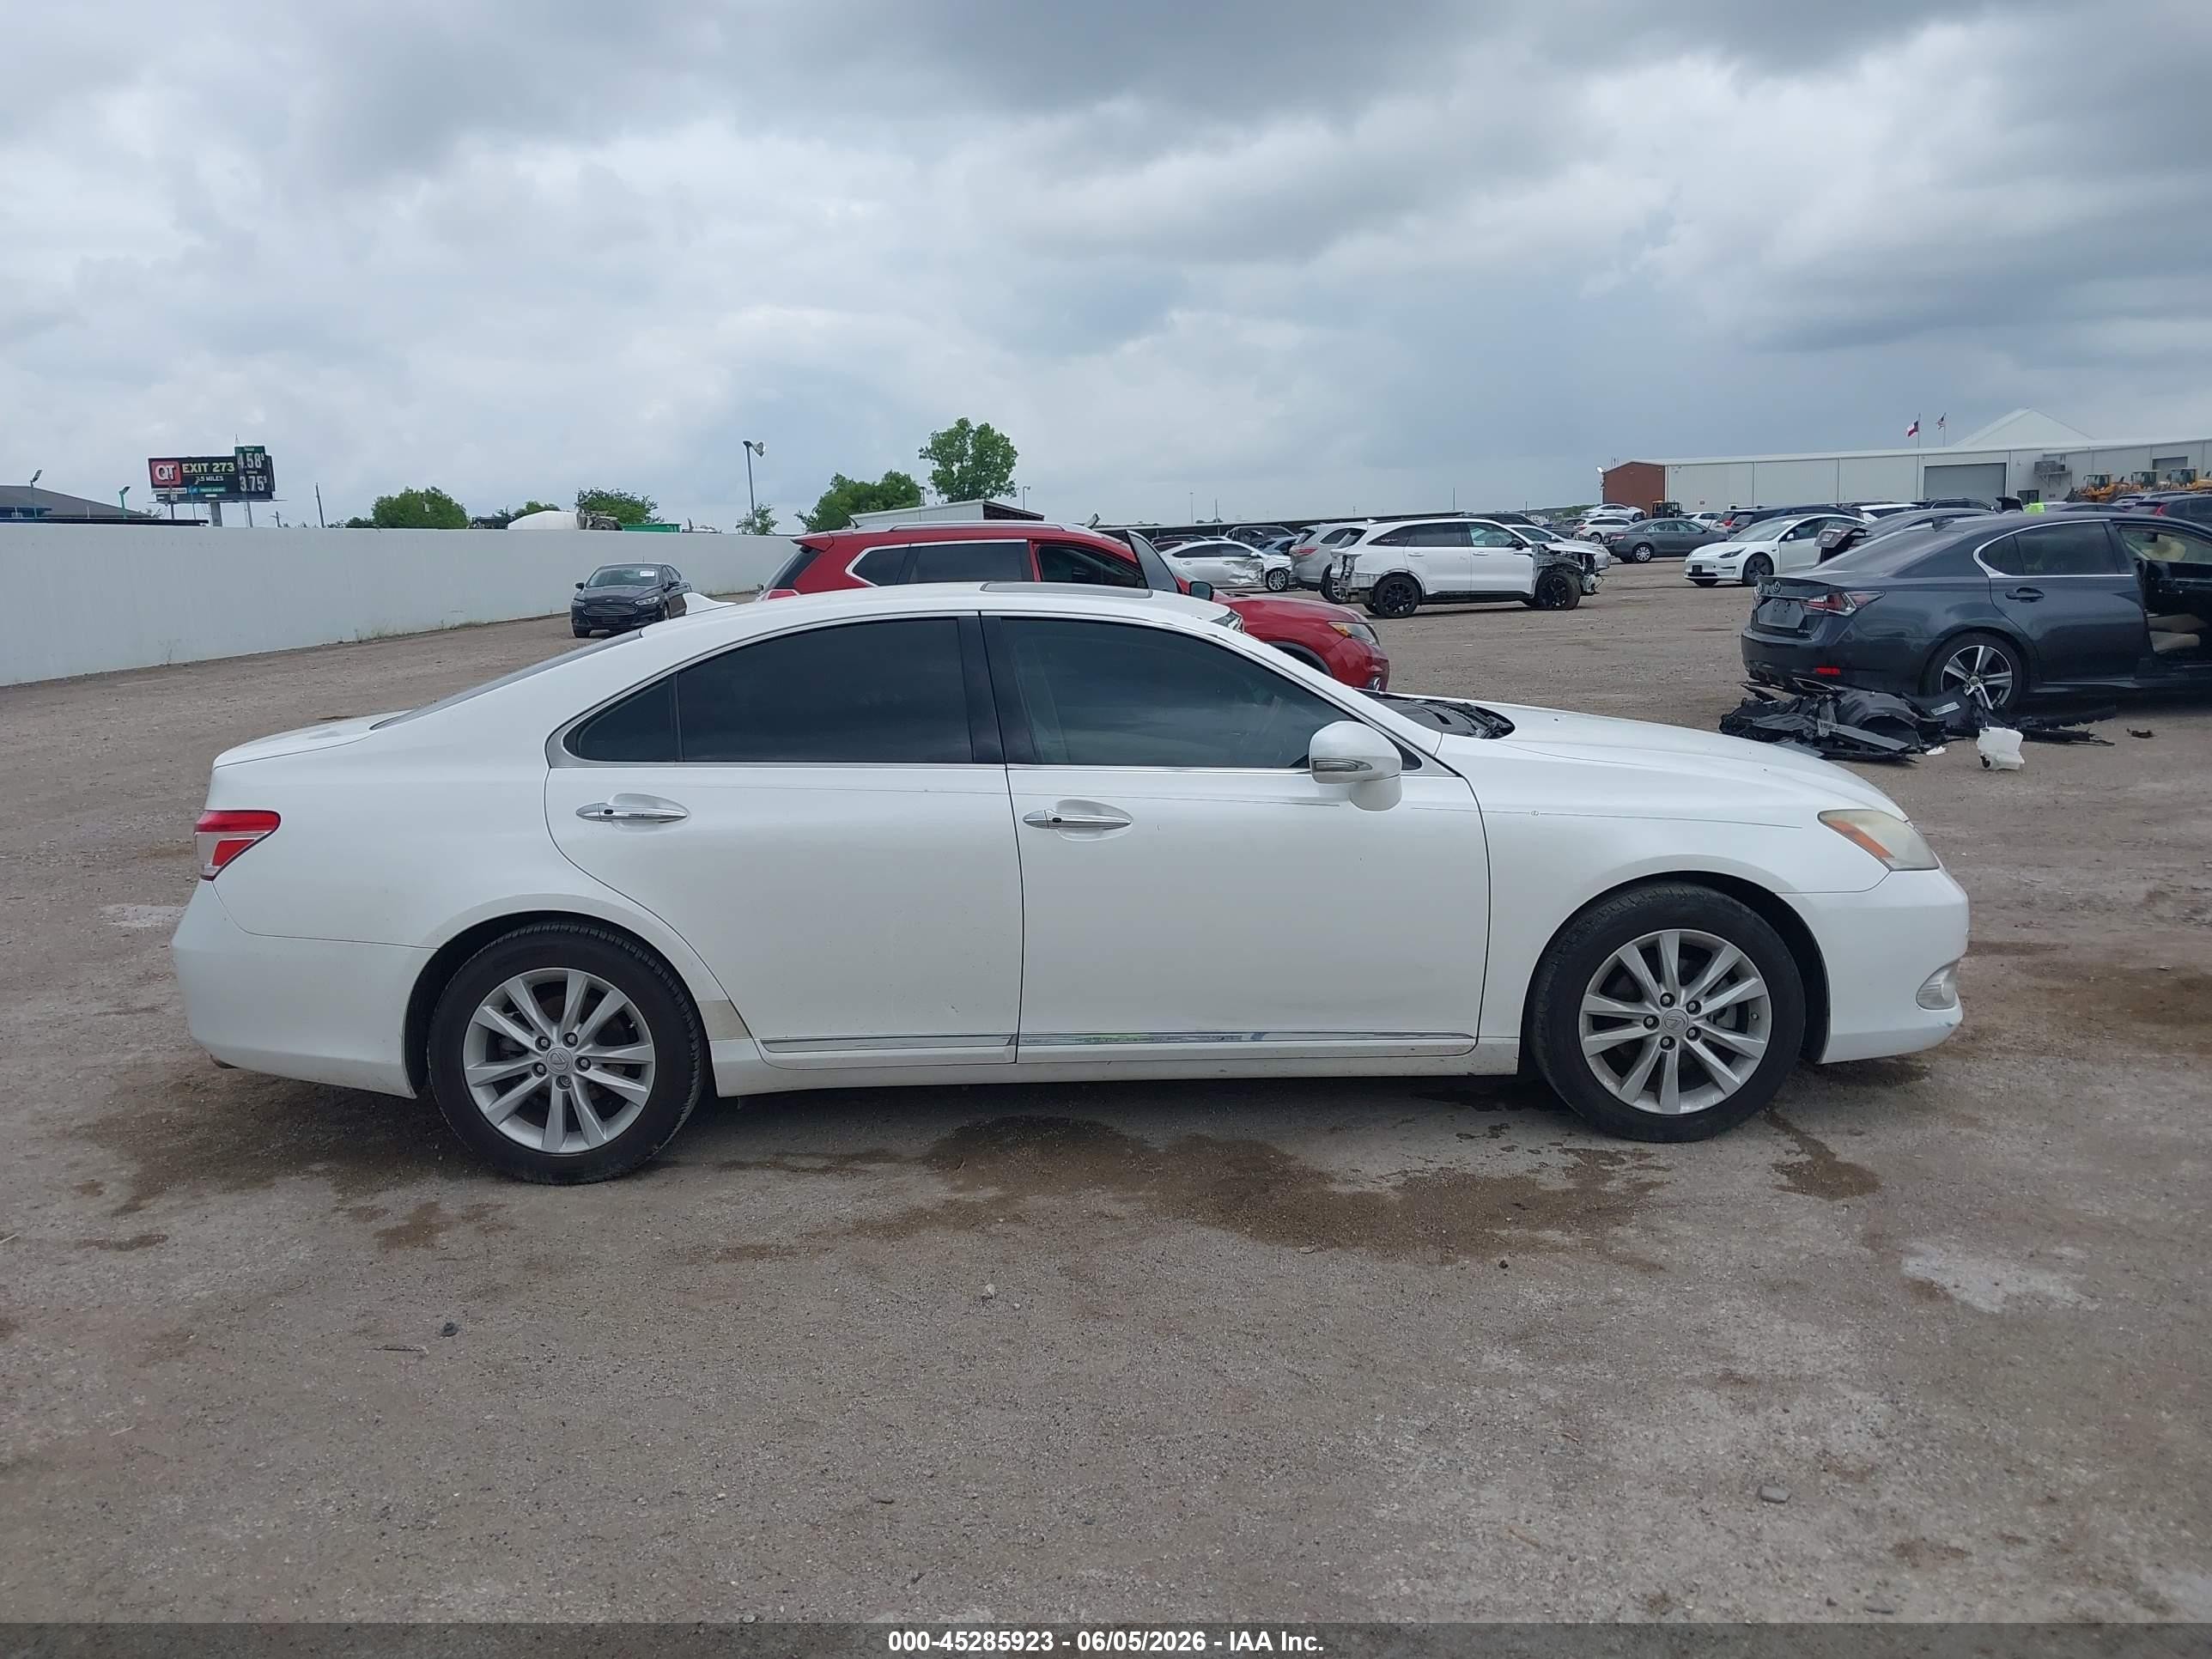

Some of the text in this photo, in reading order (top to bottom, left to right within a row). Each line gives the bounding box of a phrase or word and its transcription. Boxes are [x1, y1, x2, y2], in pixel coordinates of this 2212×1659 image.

[155, 465, 175, 481] QT
[182, 462, 235, 474] EXIT 273
